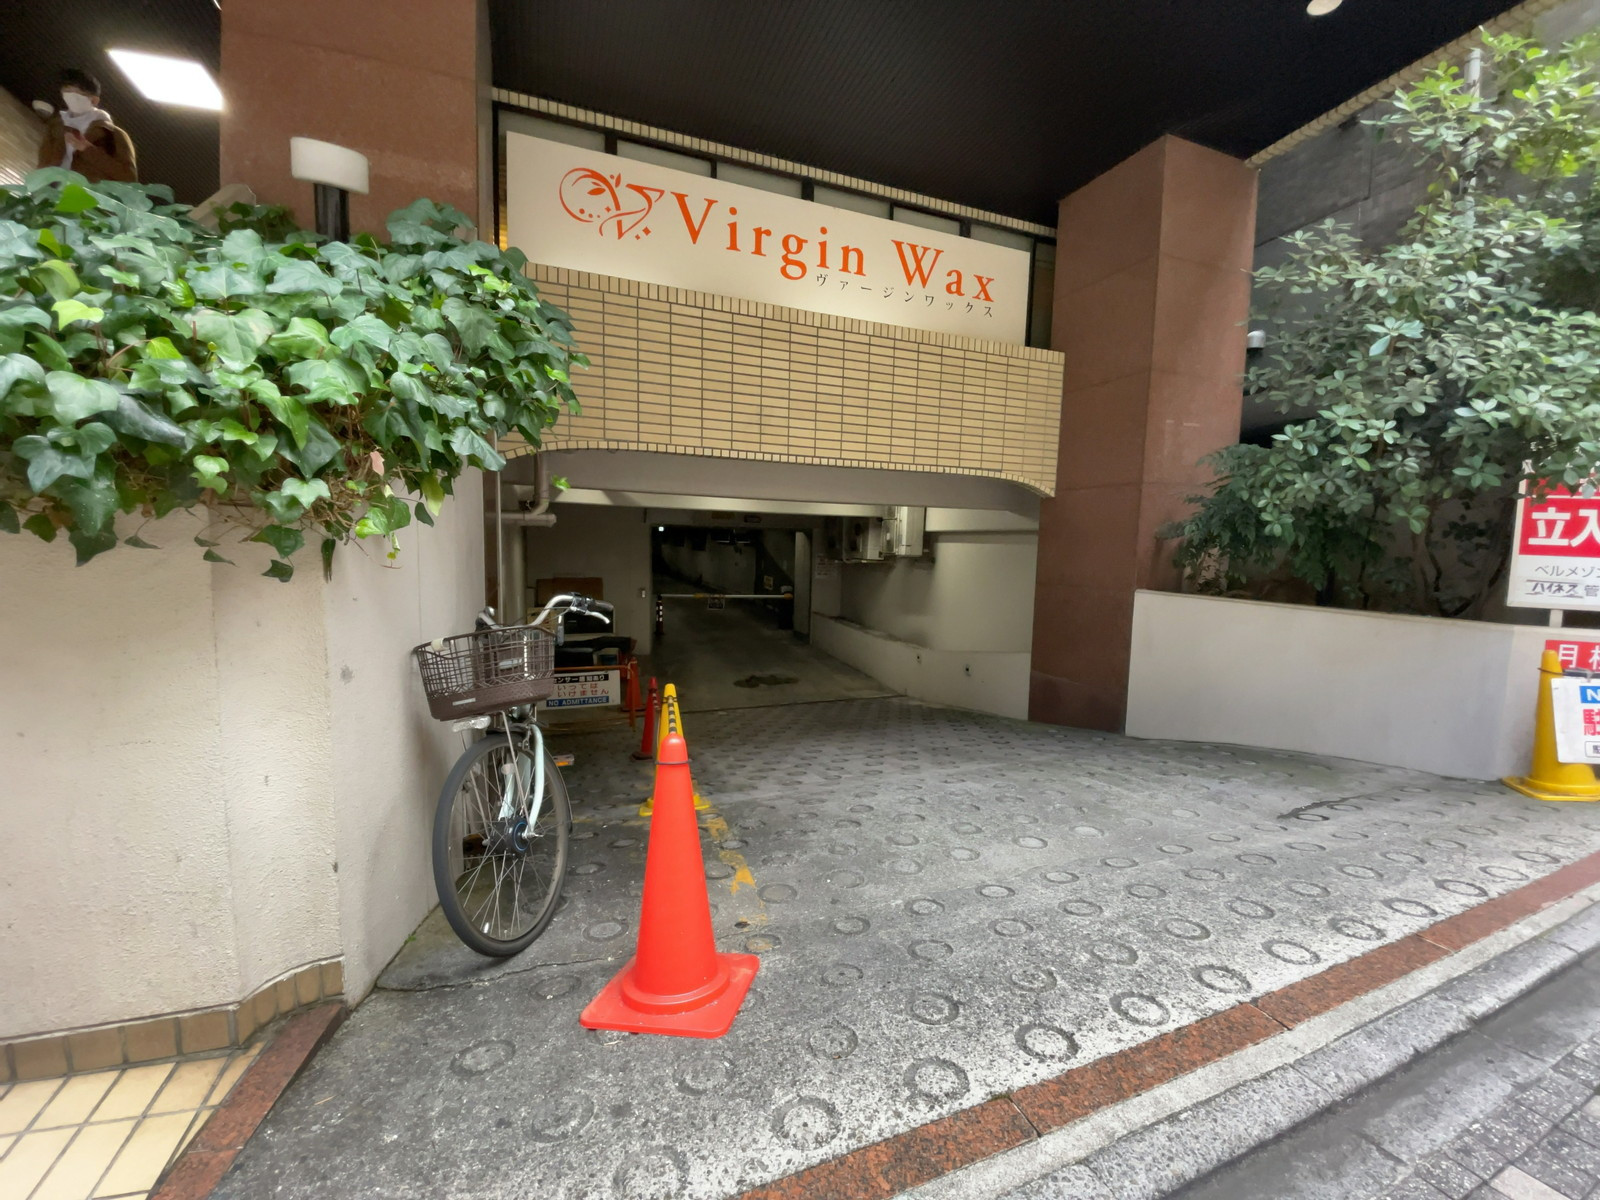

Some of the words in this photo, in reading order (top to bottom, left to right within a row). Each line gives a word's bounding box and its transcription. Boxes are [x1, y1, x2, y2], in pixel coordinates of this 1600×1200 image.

[670, 191, 867, 281] Virgin
[891, 239, 996, 303] Wax
[816, 273, 993, 318] ヴァージンワックス
[1528, 506, 1600, 548] 立入
[1534, 564, 1600, 578] ベルメゾ
[562, 696, 607, 705] ADMITTANCE
